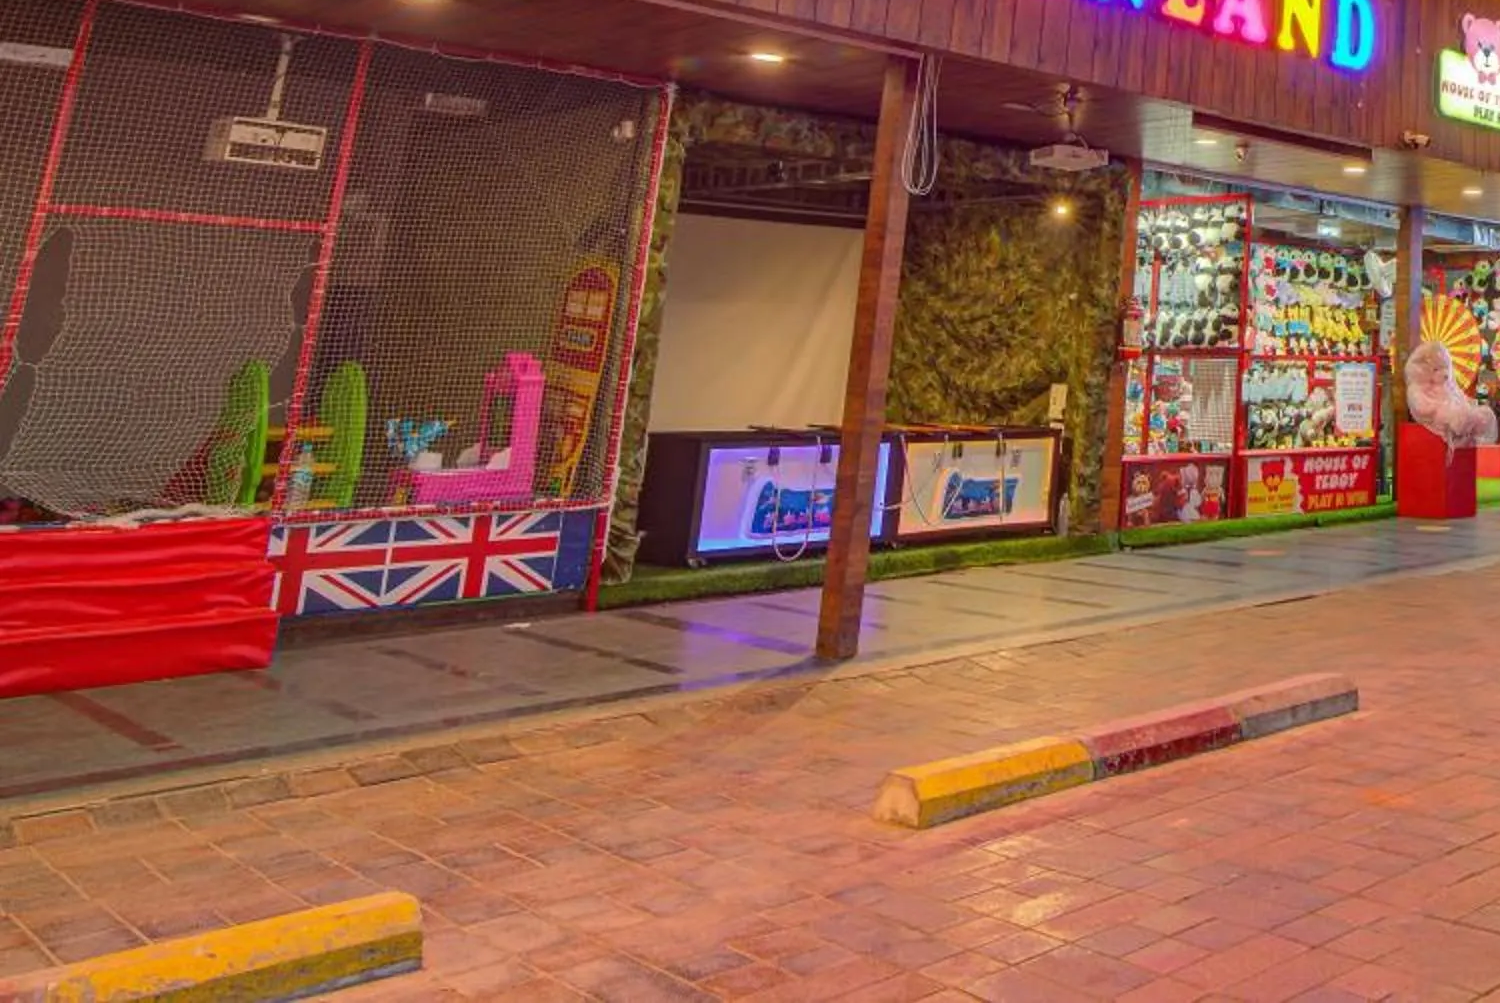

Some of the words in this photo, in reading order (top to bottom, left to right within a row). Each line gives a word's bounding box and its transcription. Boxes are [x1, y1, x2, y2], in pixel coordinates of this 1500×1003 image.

[1441, 79, 1474, 100] HOUSE
[1478, 90, 1493, 104] OF
[1303, 456, 1348, 474] HOUSE
[1352, 454, 1371, 470] OF
[1315, 471, 1359, 490] TEDDY
